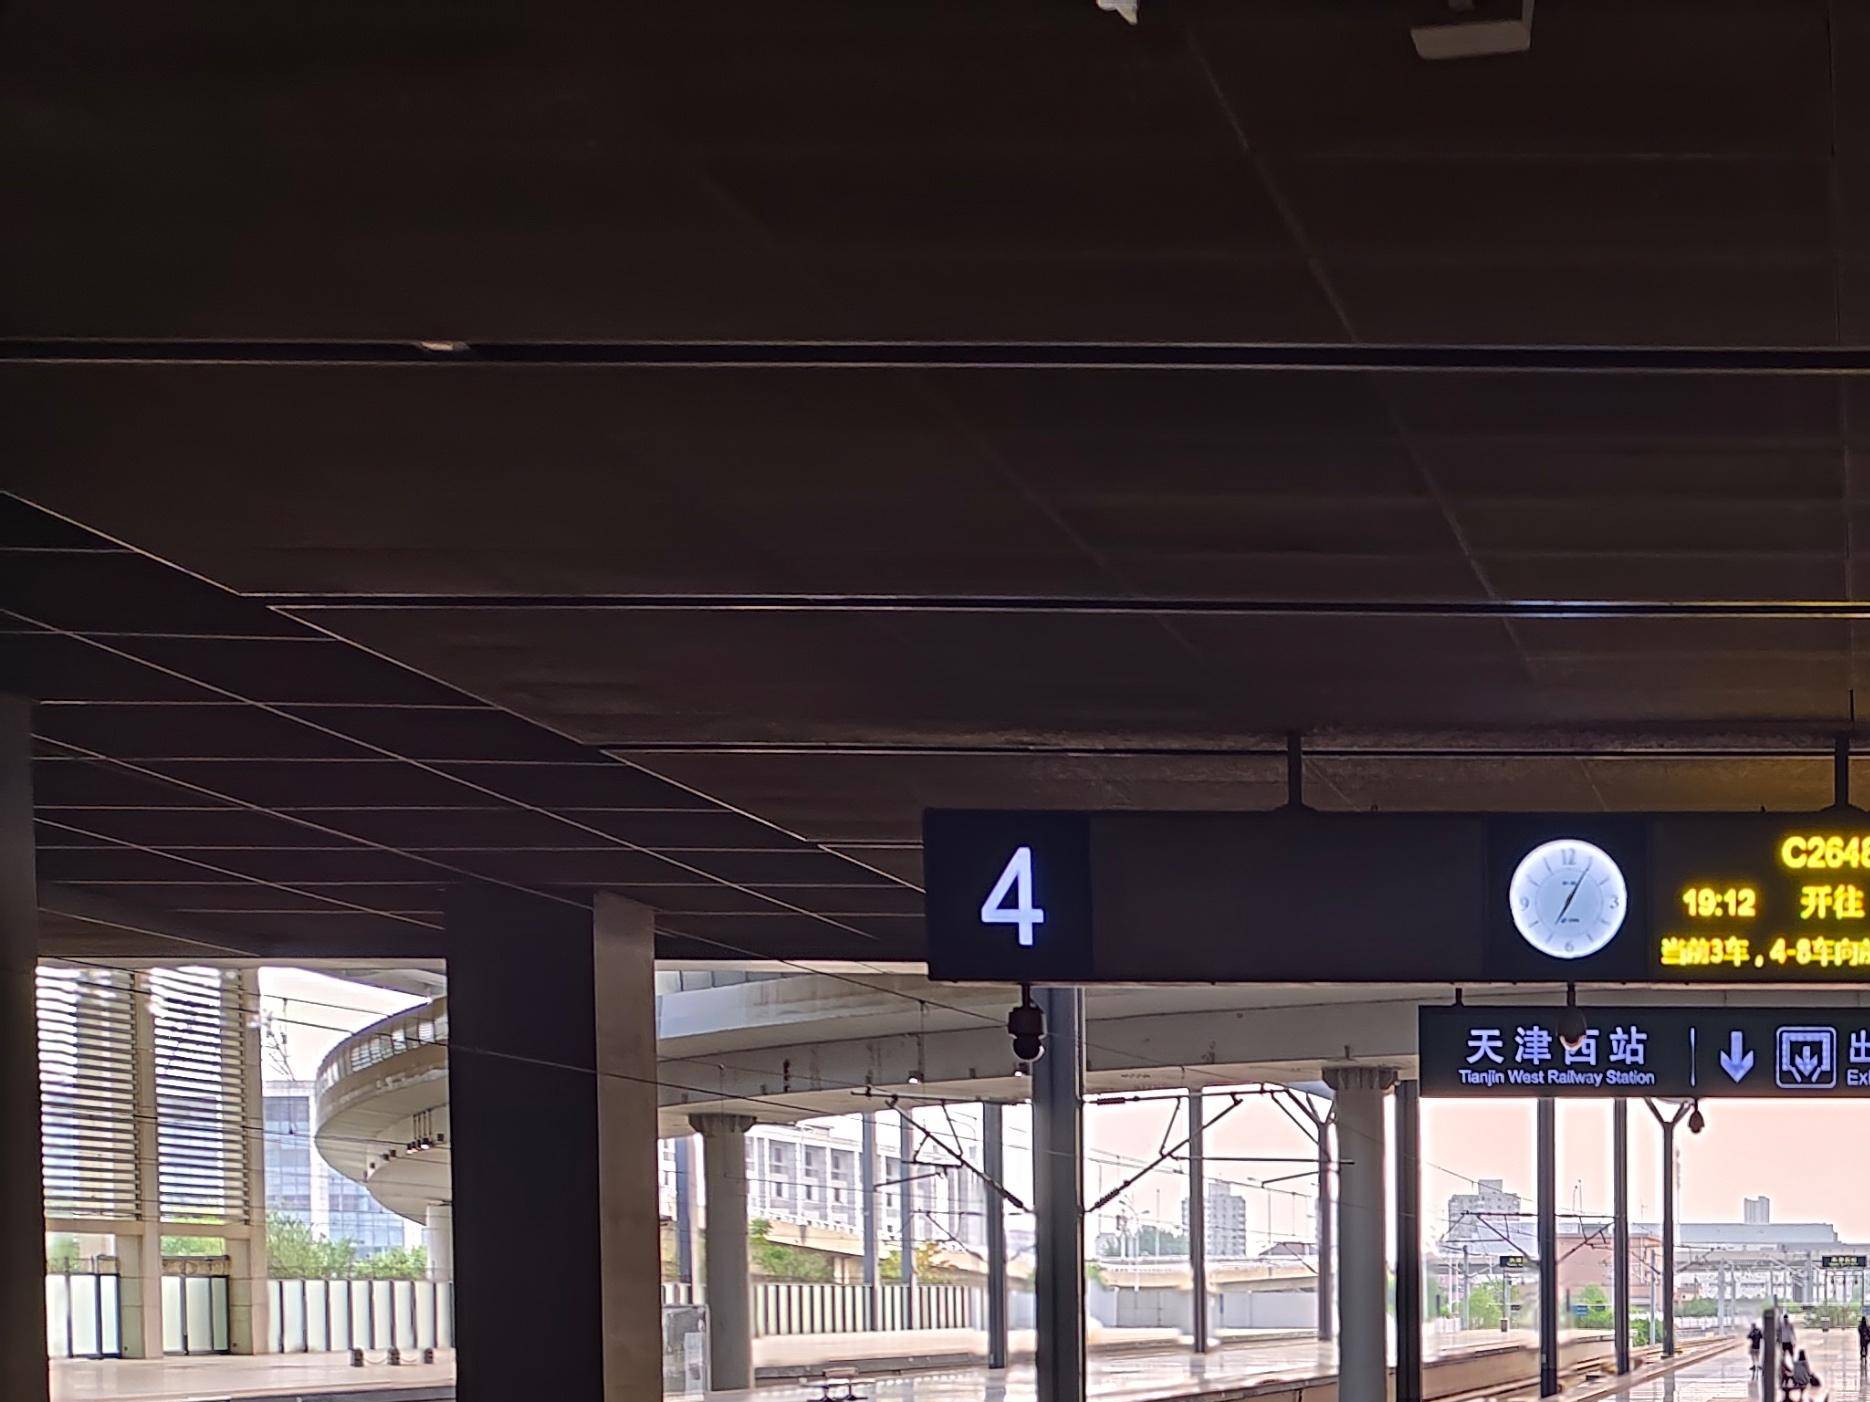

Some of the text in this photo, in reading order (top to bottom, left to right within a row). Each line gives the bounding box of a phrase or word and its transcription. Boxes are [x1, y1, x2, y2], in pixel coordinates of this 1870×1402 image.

[1561, 848, 1576, 866] 12
[981, 846, 1044, 946] 4
[1682, 888, 1757, 917] 19:12
[1800, 885, 1866, 919] 开往
[1465, 1025, 1648, 1066] 天津西站
[1458, 1069, 1655, 1087] Tianjin West Railway Station
